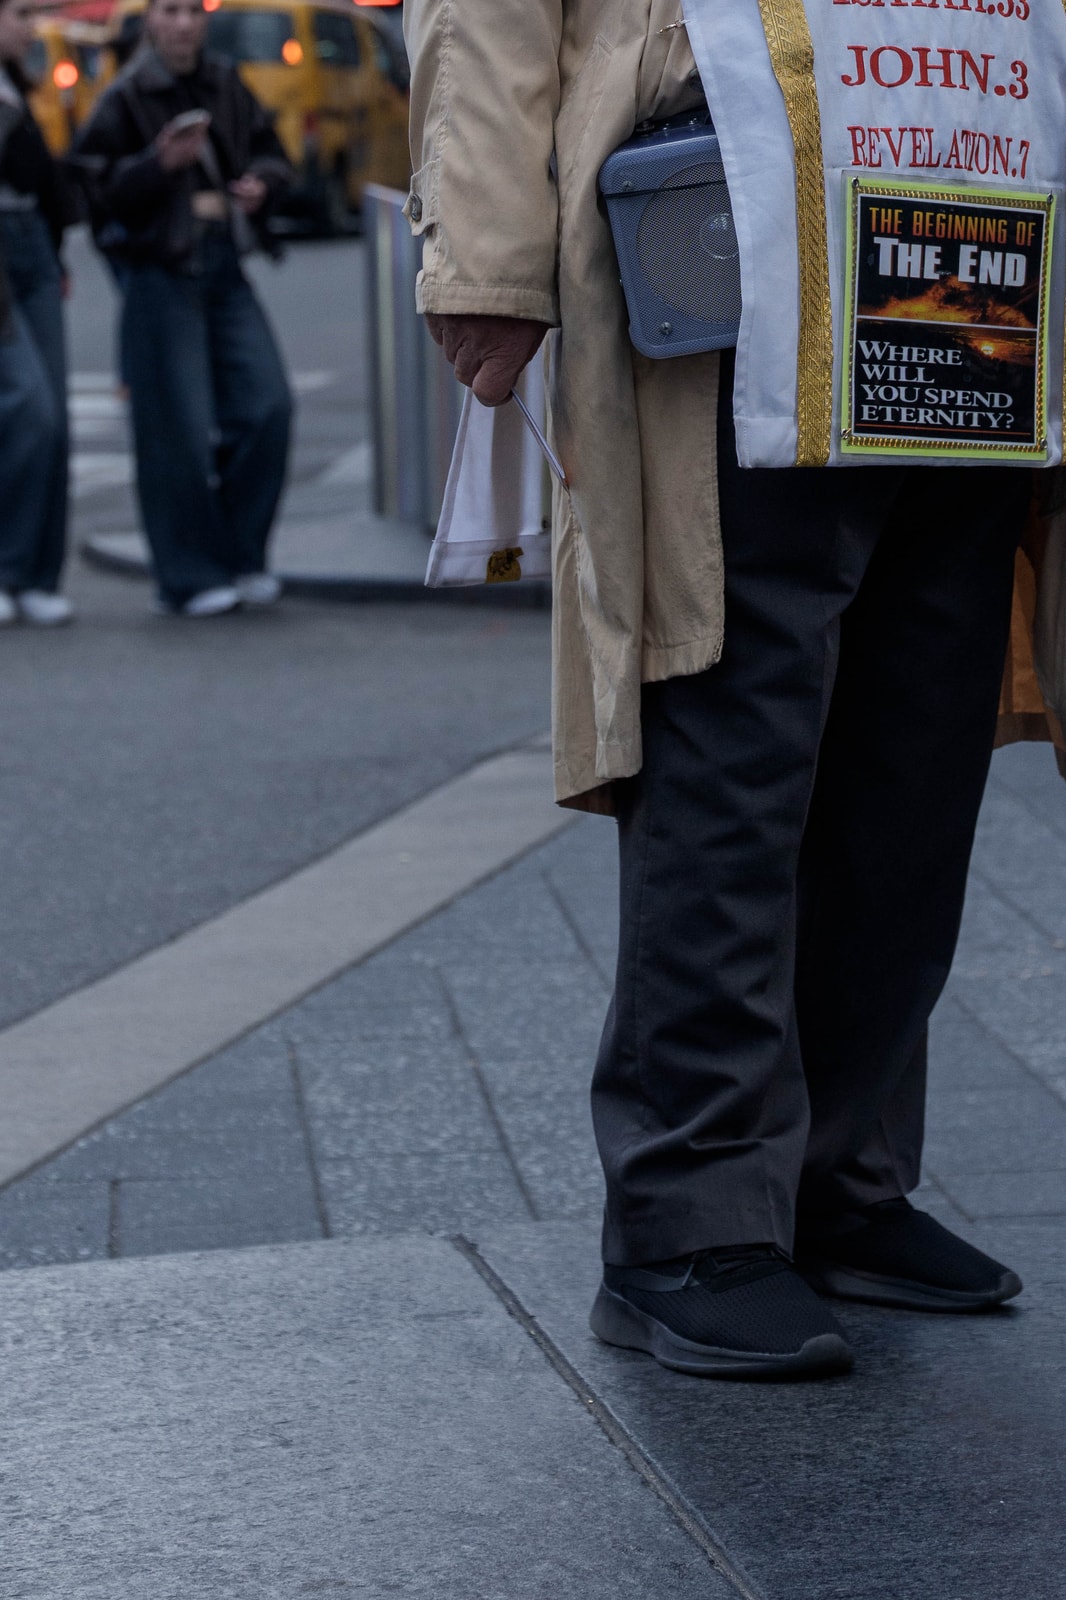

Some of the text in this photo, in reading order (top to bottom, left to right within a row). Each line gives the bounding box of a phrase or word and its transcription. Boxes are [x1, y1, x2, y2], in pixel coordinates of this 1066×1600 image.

[841, 45, 1029, 99] JOHN.3
[869, 207, 1036, 247] THE BEGINNING OF
[874, 236, 1027, 288] THE END
[858, 340, 963, 367] WHERE
[861, 363, 936, 384] WILL
[861, 384, 1013, 409] YOU SPEND
[860, 404, 1015, 430] ETERNITY?
